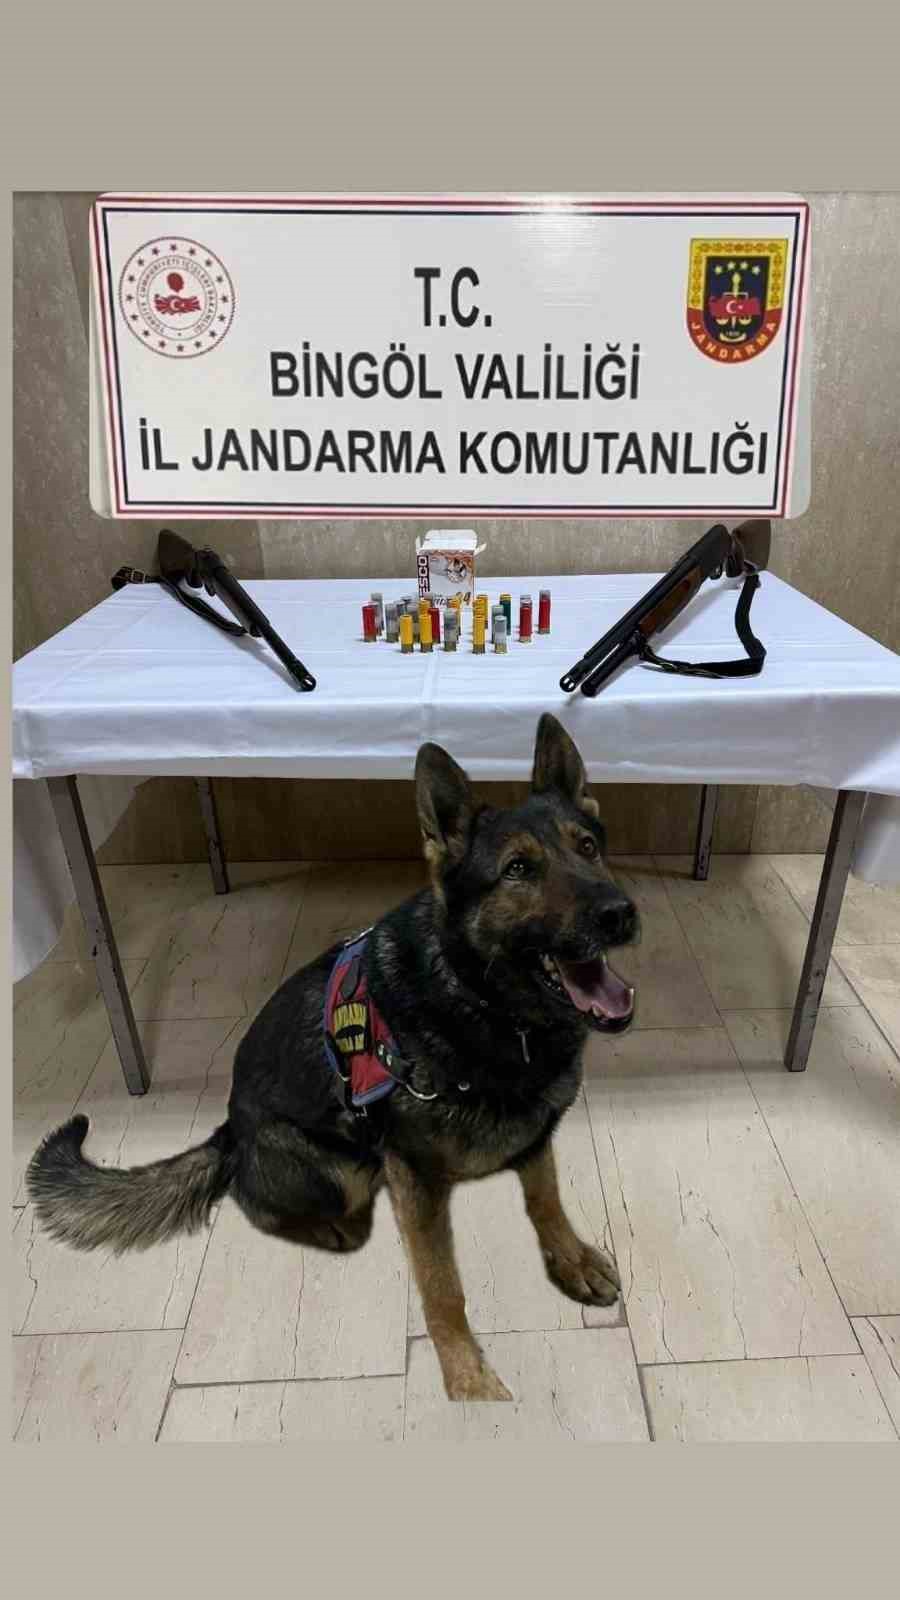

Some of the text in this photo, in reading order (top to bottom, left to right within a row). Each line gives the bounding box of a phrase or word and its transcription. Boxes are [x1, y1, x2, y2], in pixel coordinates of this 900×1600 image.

[414, 266, 492, 328] T.C.
[691, 321, 777, 359] JANDARMA
[269, 341, 640, 401] BİNGÖL VALİLİĞİ
[139, 417, 768, 475] İL JANDARMA KOMUTANLIĞI
